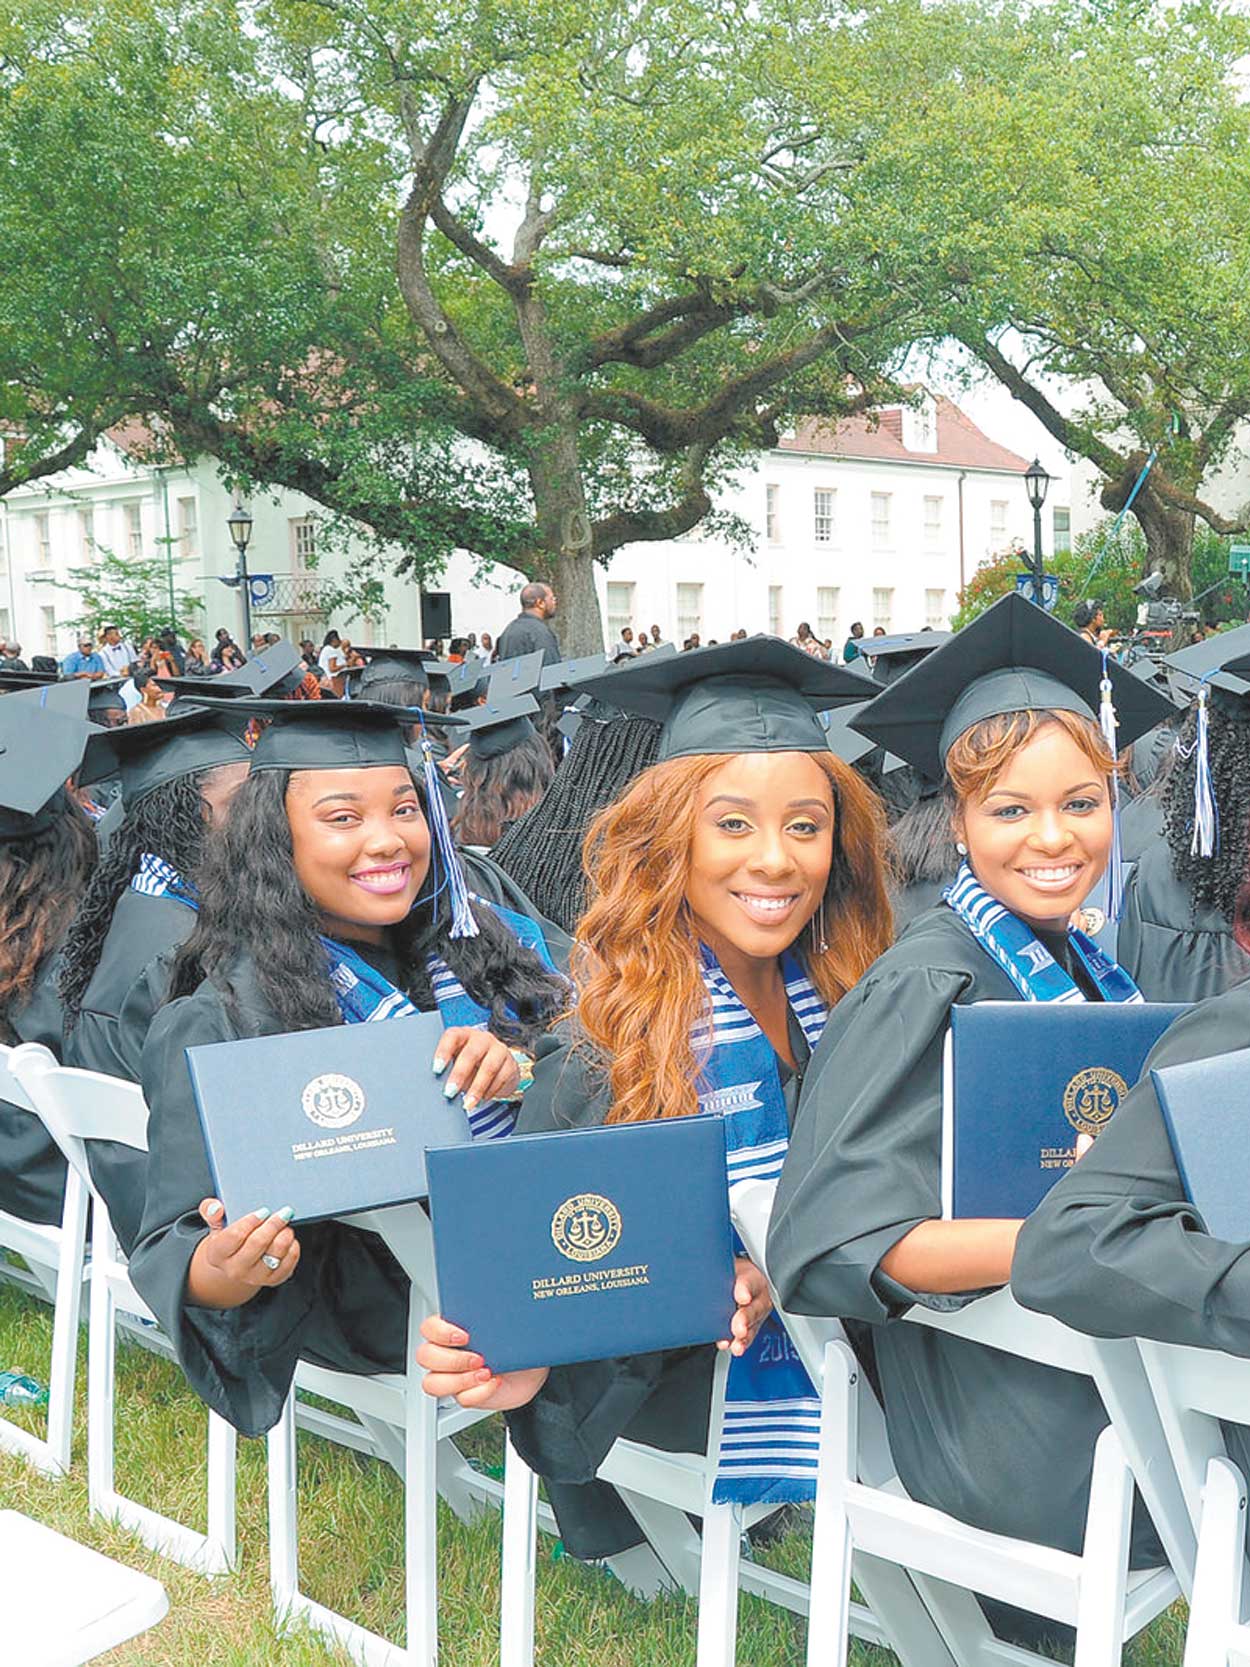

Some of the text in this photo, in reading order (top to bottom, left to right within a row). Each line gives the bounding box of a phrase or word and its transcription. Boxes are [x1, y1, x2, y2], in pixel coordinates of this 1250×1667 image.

[292, 1127, 395, 1154] DILLARD UNIVERSITY
[532, 1264, 649, 1290] DILLARD UNIVERSITY
[533, 1275, 650, 1300] NEW ORLEANS, LOUISIANA
